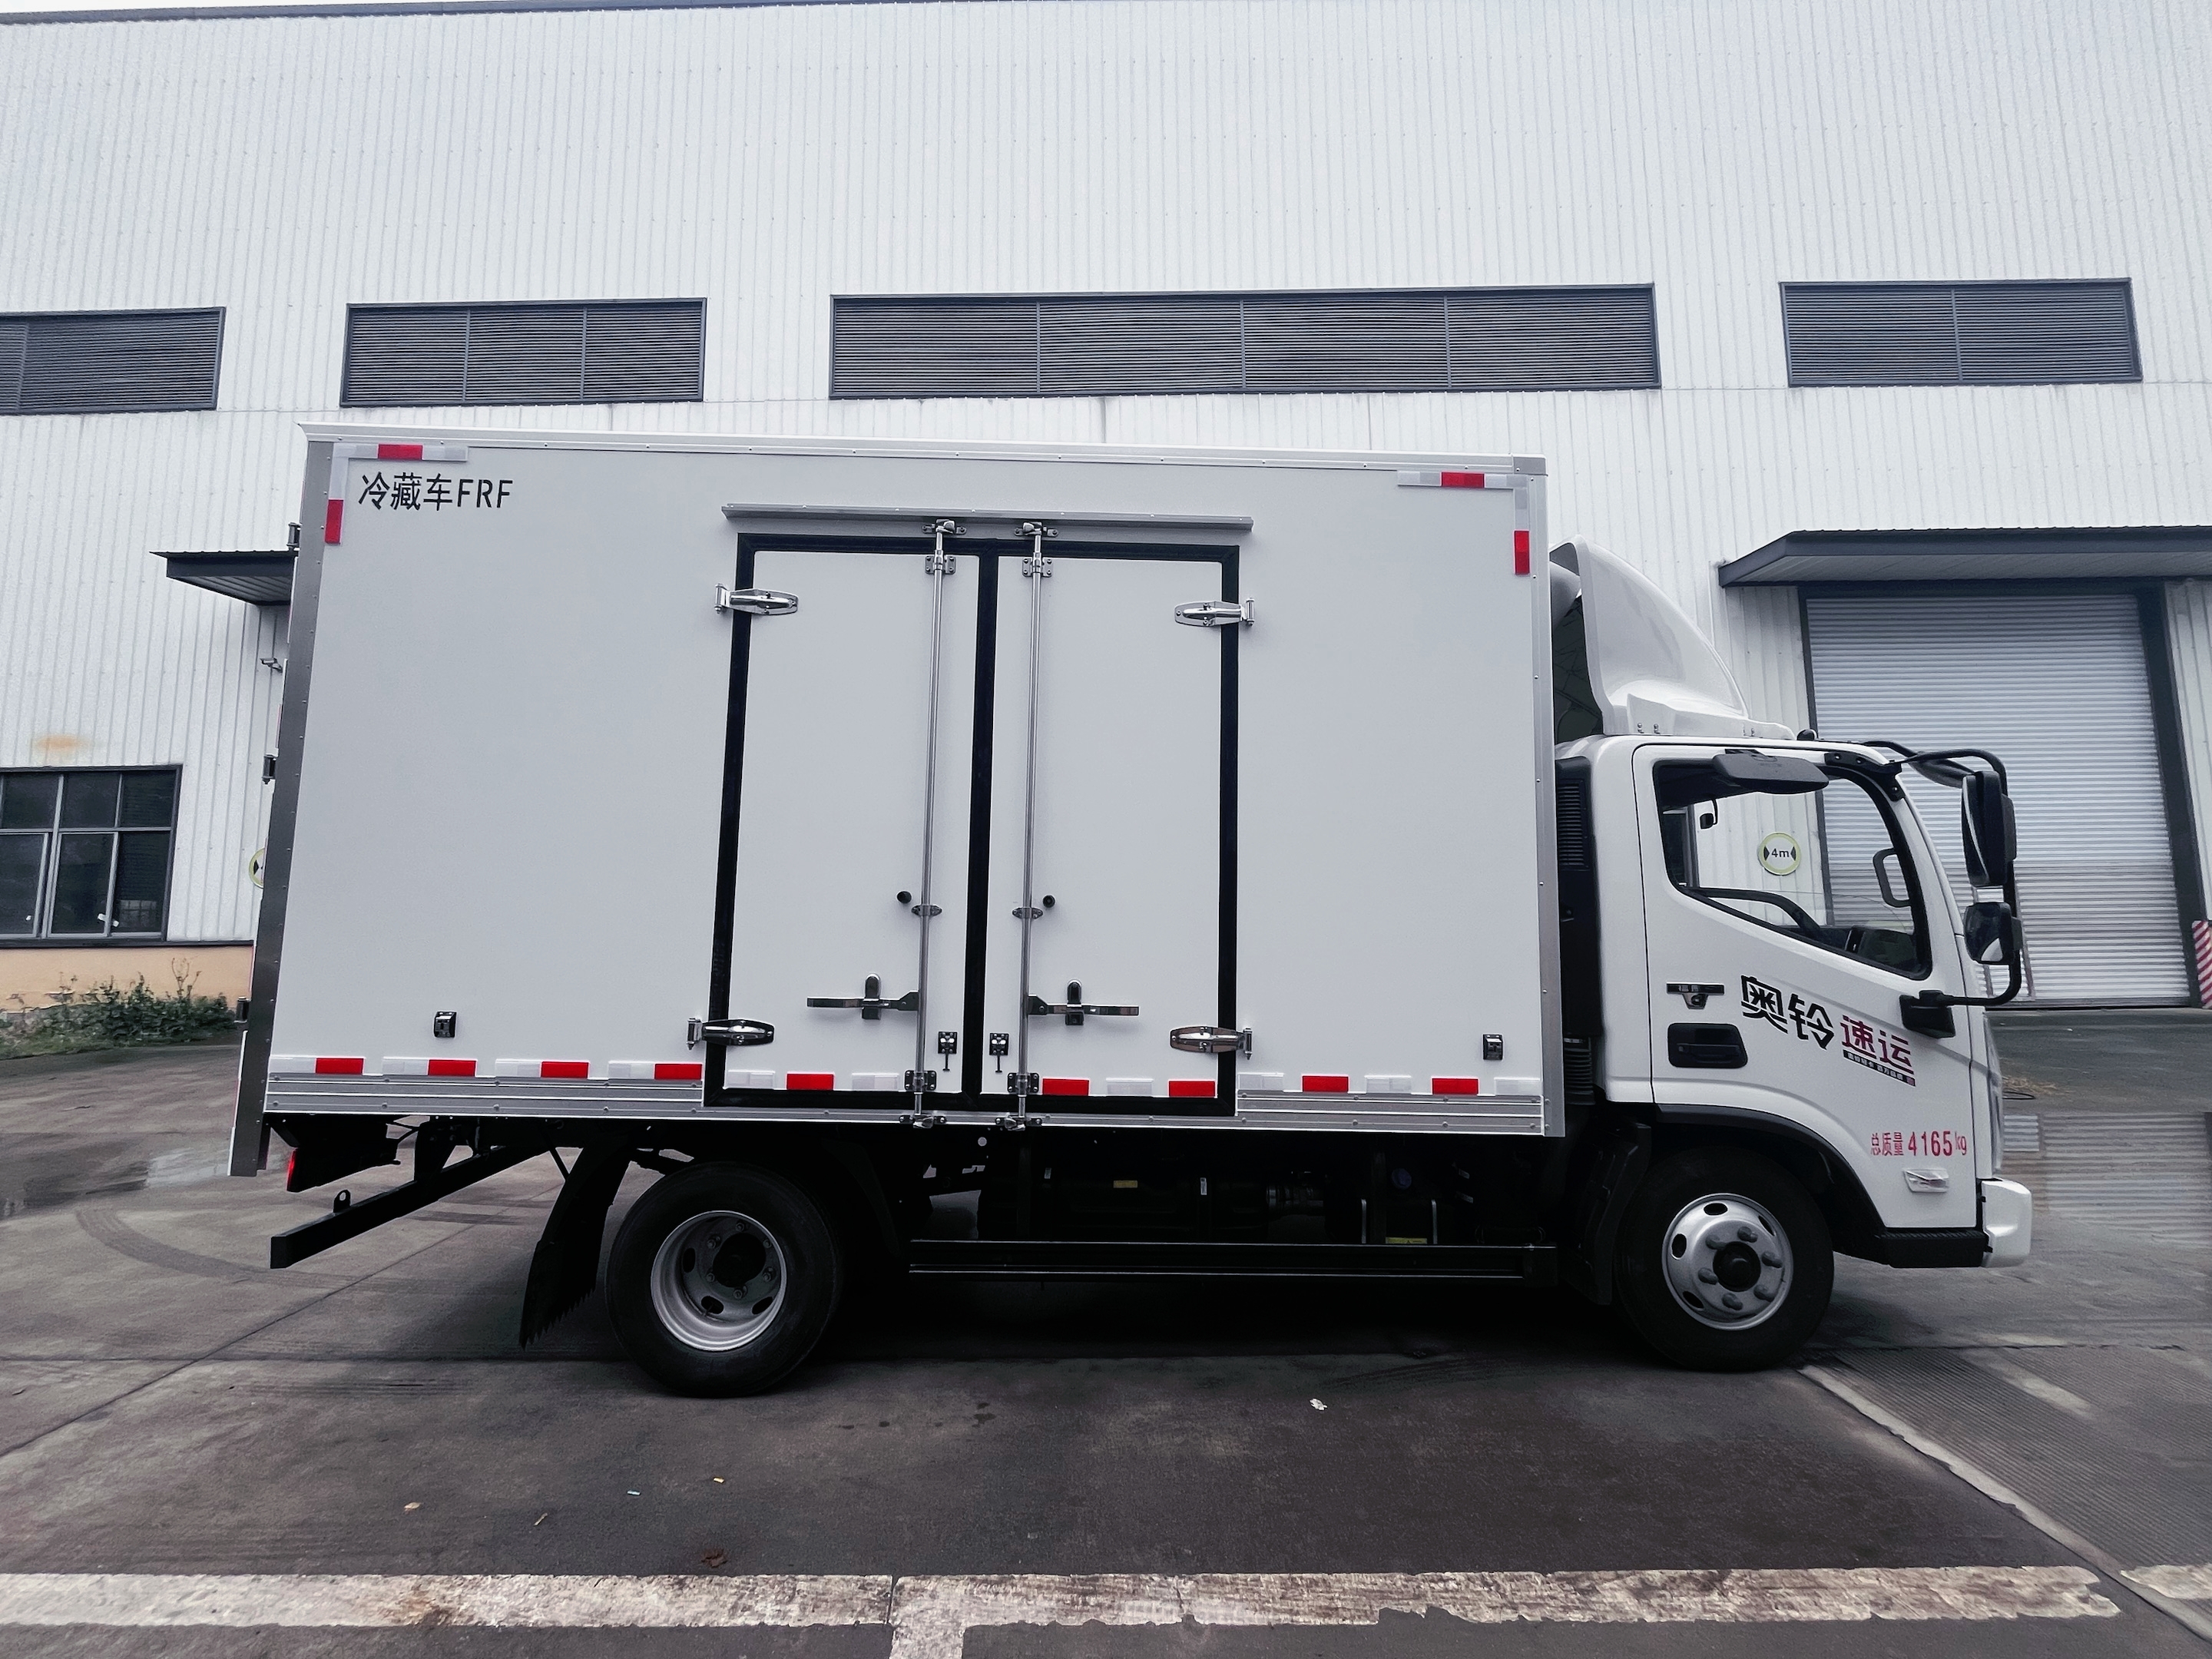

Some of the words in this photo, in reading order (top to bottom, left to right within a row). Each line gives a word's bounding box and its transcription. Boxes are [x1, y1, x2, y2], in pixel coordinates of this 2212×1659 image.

[358, 472, 513, 511] 冷藏车FRF
[1771, 848, 1790, 858] 4m
